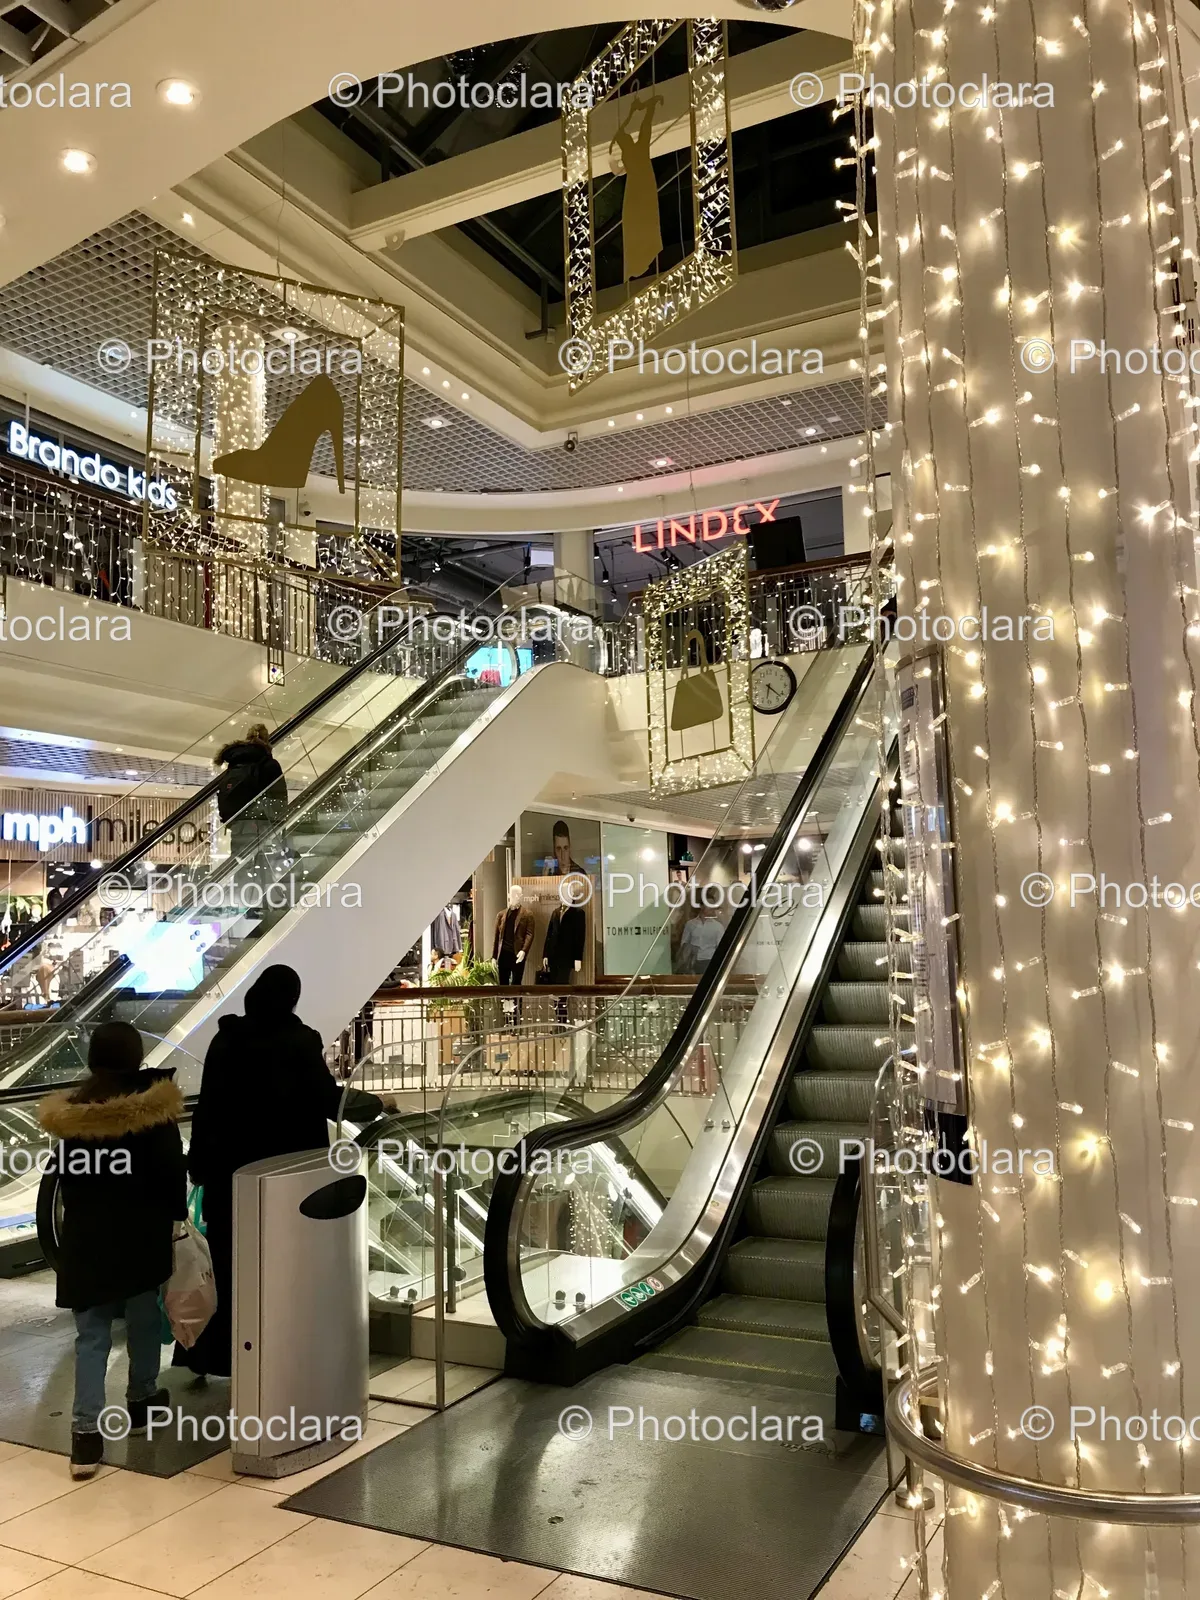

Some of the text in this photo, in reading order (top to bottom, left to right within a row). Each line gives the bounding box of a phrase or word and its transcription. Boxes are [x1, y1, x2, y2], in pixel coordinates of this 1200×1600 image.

[9, 421, 177, 510] Brando kids
[634, 499, 780, 553] LINDEX
[3, 806, 87, 851] mph
[606, 926, 633, 936] TOMMY
